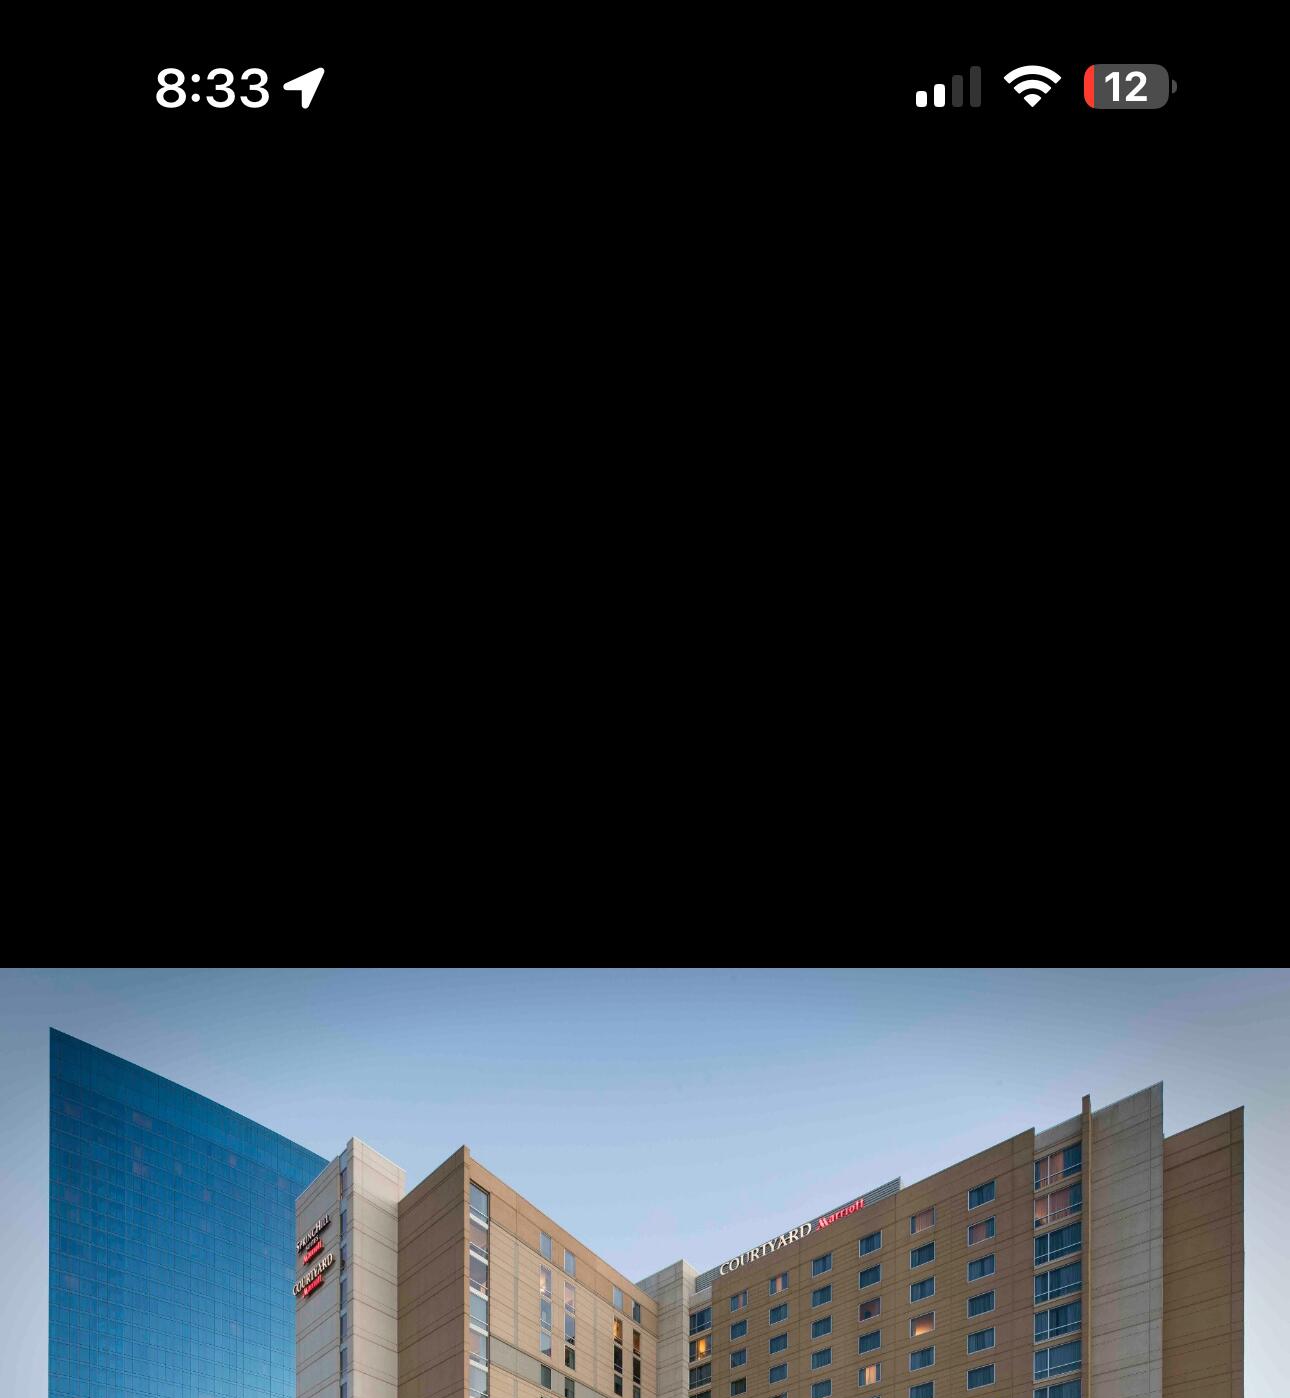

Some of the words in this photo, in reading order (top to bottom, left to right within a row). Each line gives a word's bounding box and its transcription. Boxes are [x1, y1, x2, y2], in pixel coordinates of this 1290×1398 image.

[719, 1223, 812, 1276] COURTYARD
[815, 1197, 865, 1232] Marriott
[292, 1253, 334, 1296] COURTYARD
